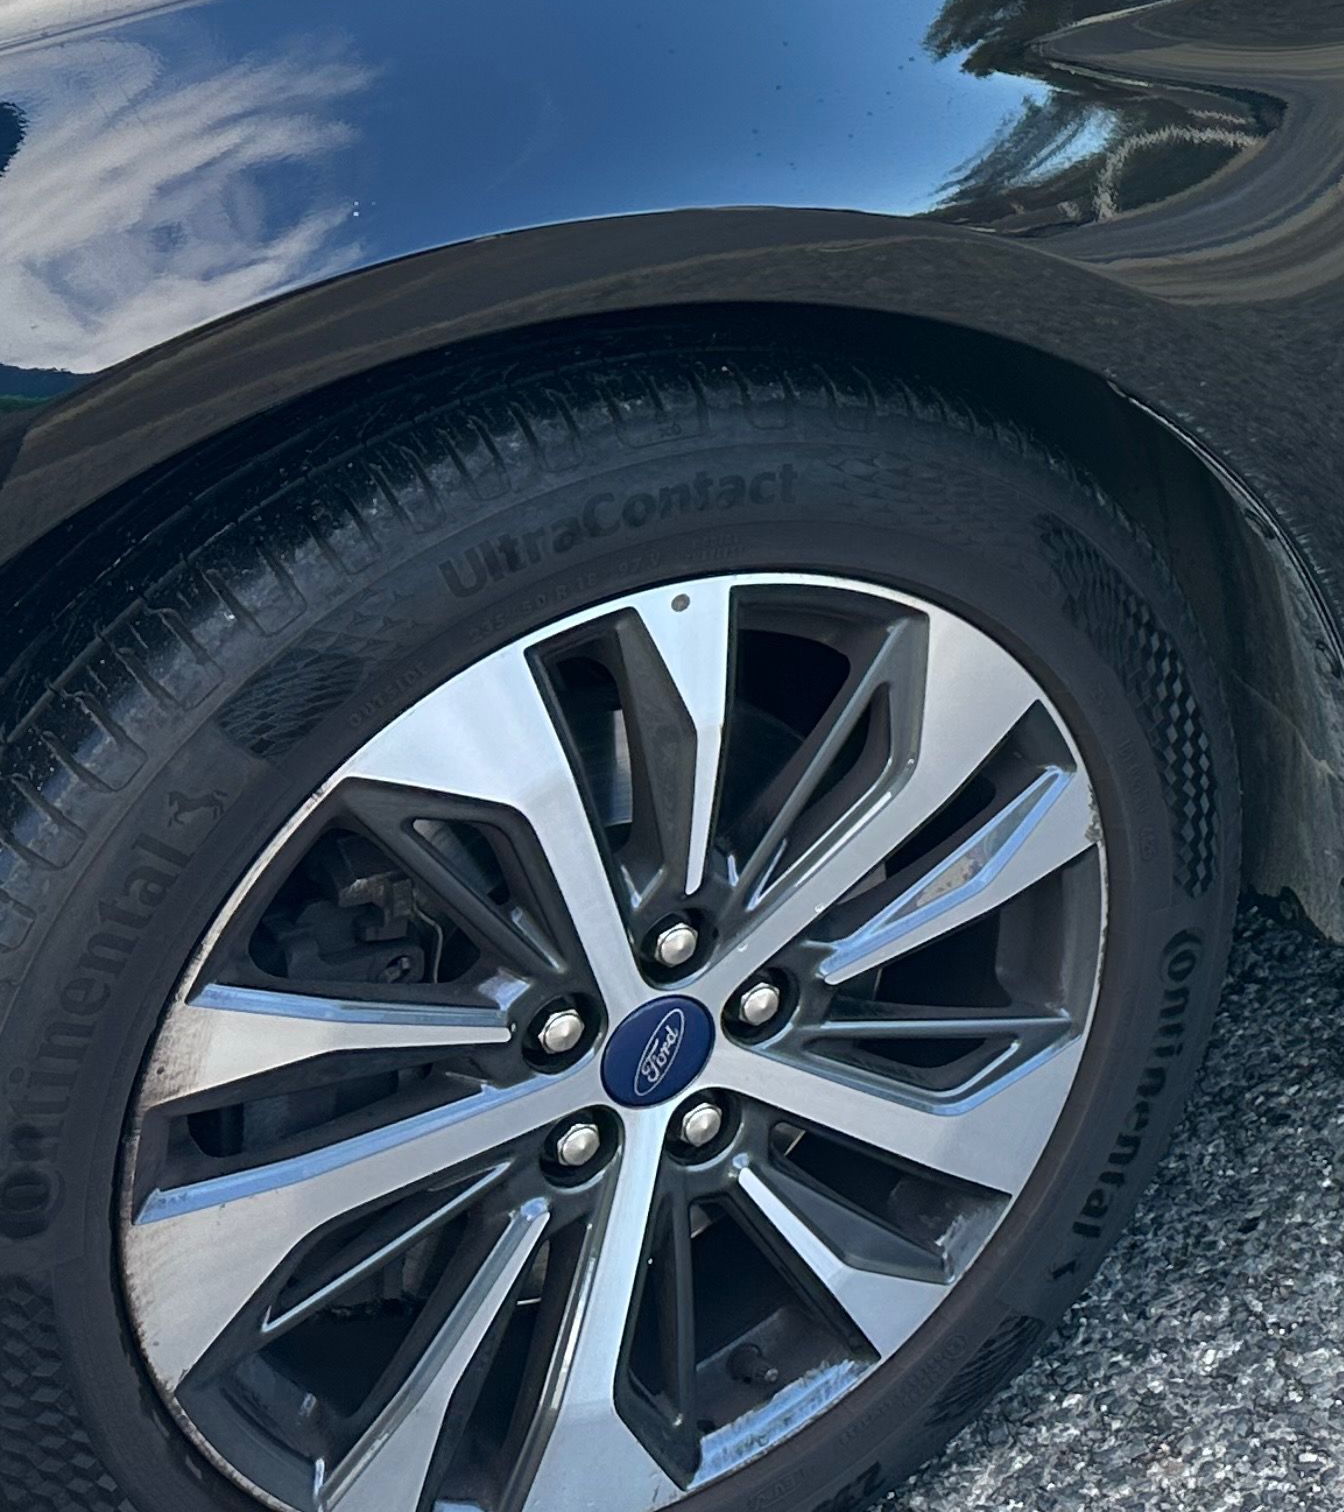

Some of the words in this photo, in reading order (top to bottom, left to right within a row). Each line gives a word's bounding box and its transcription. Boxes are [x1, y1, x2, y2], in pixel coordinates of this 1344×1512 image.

[438, 462, 799, 598] UltraContact
[0, 831, 196, 1240] Continental
[640, 1023, 680, 1084] Ford
